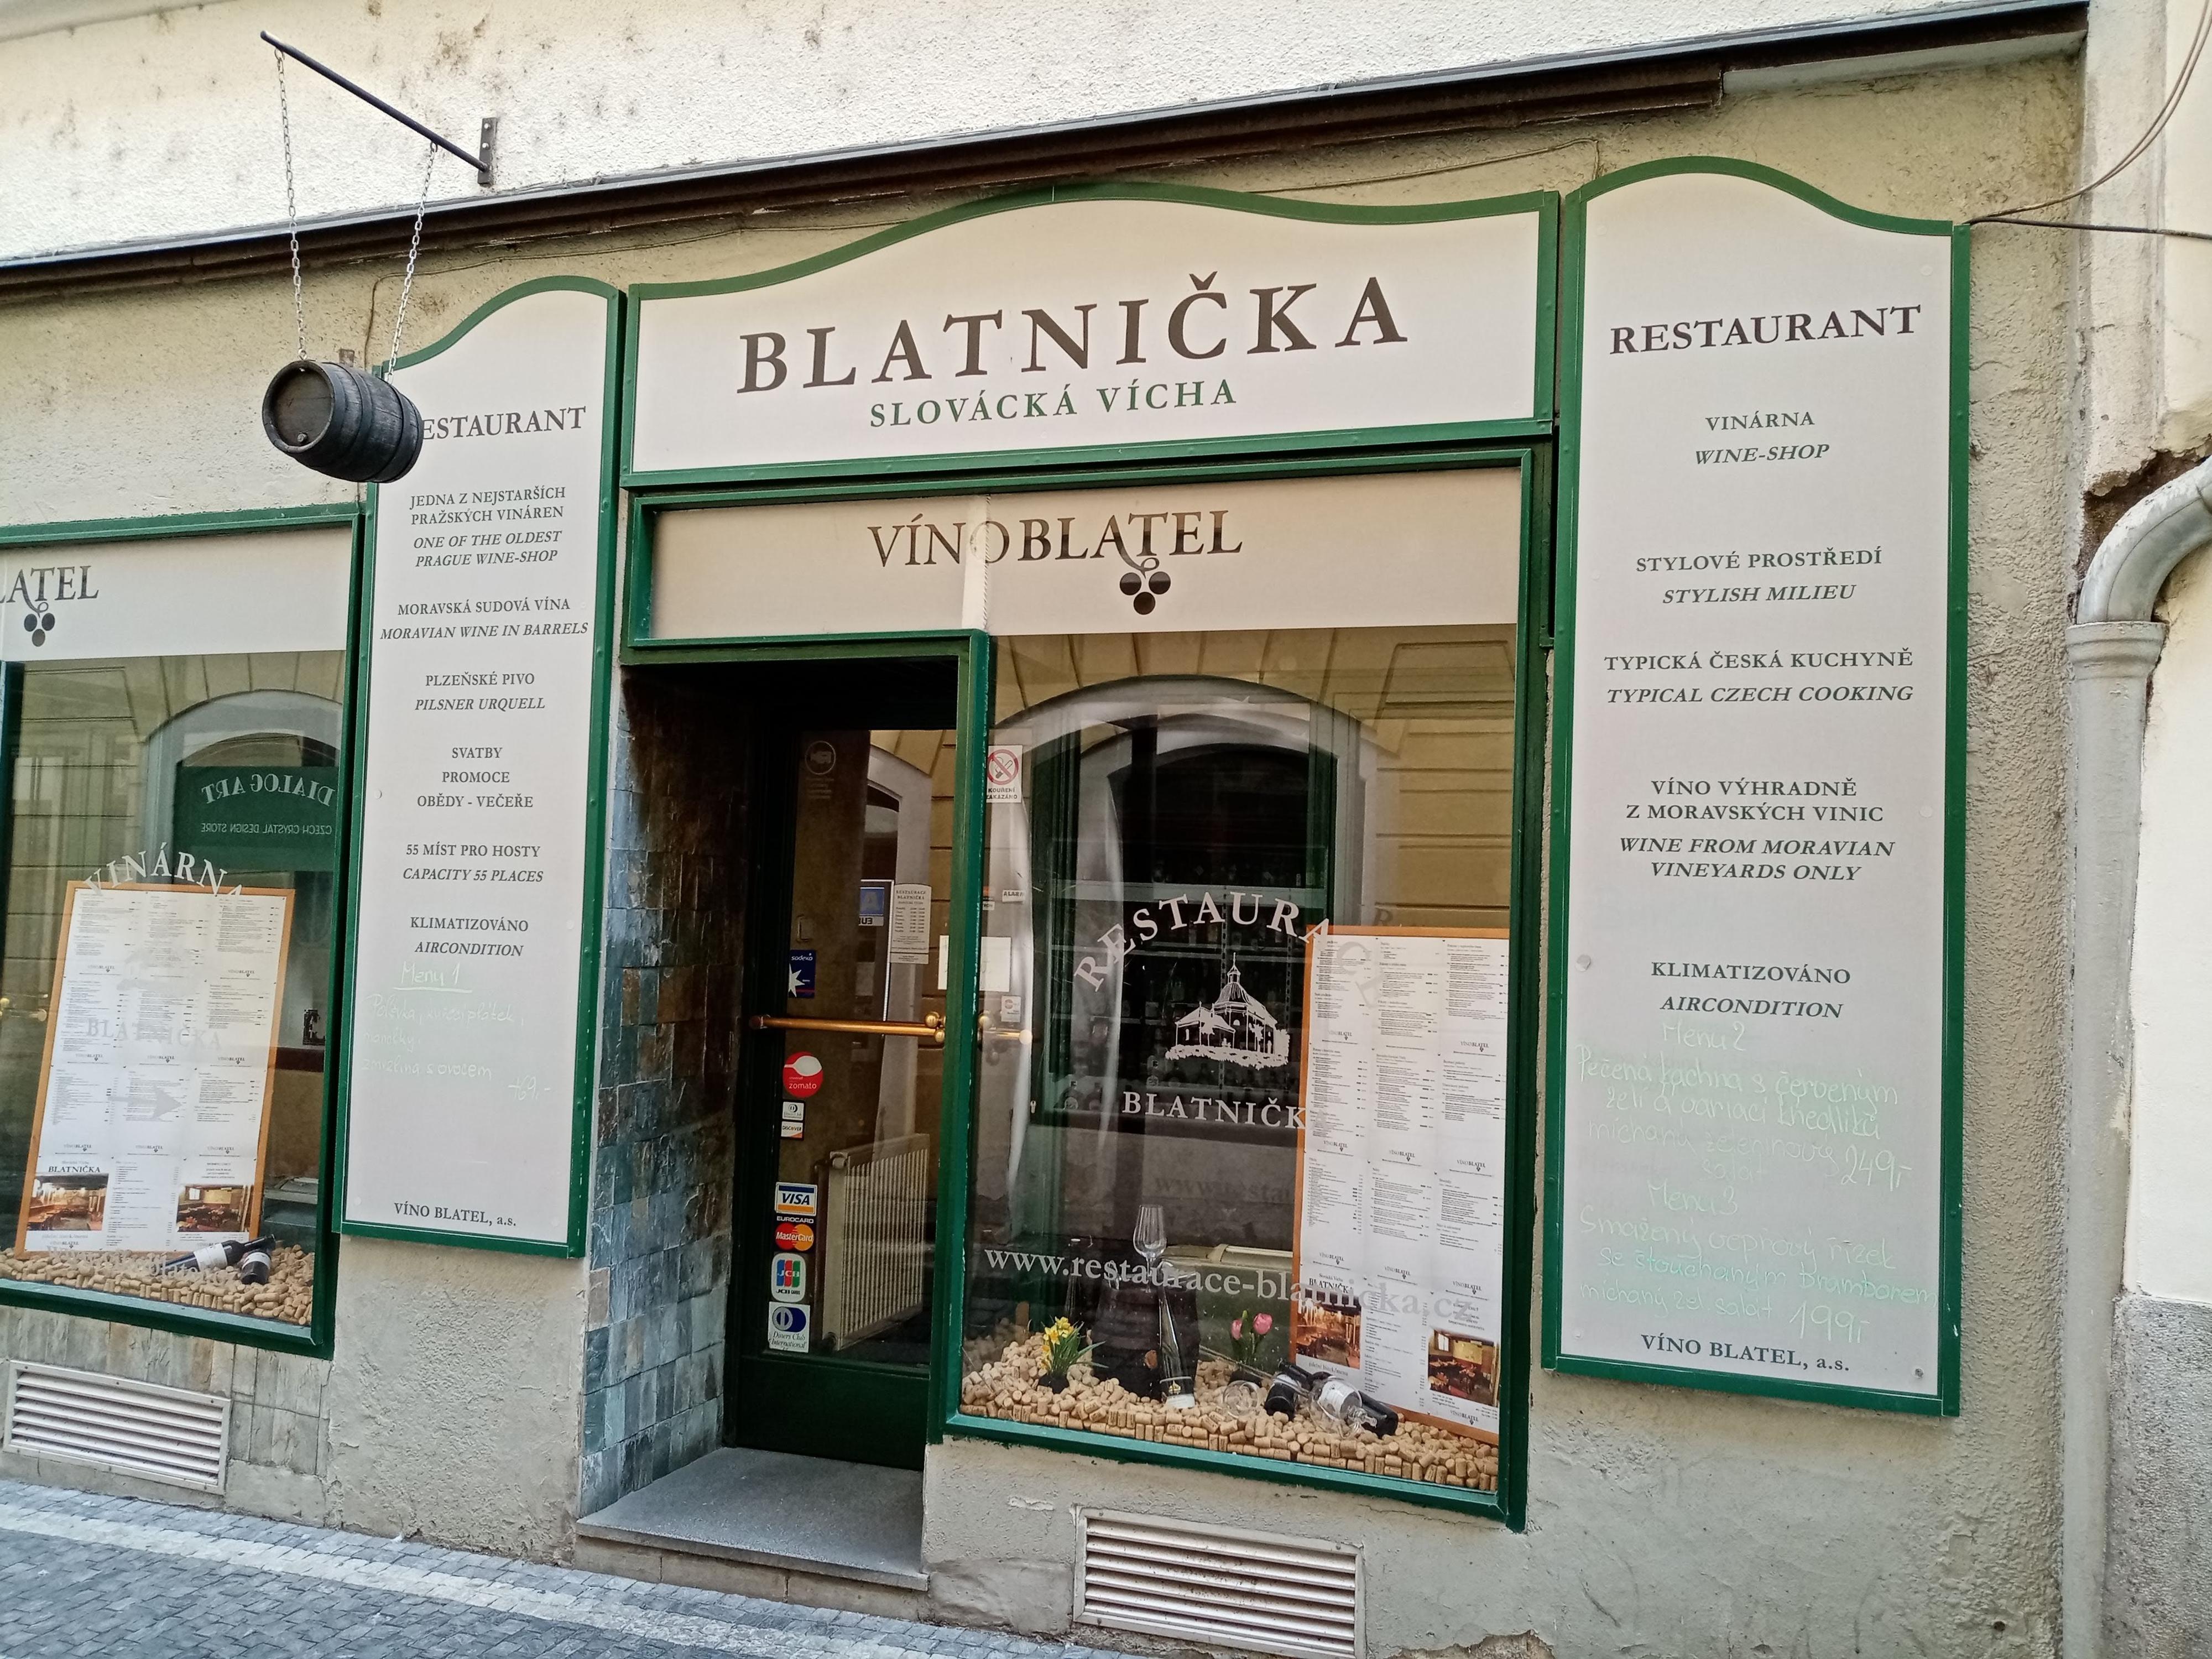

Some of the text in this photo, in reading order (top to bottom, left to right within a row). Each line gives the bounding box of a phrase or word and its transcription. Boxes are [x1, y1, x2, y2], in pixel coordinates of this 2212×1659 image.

[737, 272, 1408, 395] BLATNIČKA
[1609, 304, 1921, 355] RESTAURANT
[870, 378, 1237, 427] SLOVÁCKÁ VÍCHA
[420, 406, 587, 441] ESTAURANT
[1705, 410, 1815, 431] VINÁRNA
[1695, 444, 1830, 465] WINE-SHOP
[409, 485, 566, 510] JEDNA Z NEJSTARŠÍCH
[411, 504, 564, 525] PRAŽSKÝCH VINÁREN
[414, 530, 562, 549] ONE OF THE OLDEST
[415, 550, 558, 567] PRAGUE WINE-SHOP
[1636, 545, 1882, 572] STYLOVÉ PROSTŘEDÍ
[1662, 585, 1857, 604] STYLISH MILIEU
[398, 596, 571, 615] MORAVSKÁ SUDOVÁ VÍNA
[380, 622, 588, 639] MORAVIAN WINE IN BARRELS
[1604, 647, 1913, 670] TYPICKÁ ČESKÁ KUCHYNĚ
[425, 671, 535, 686] PLZEŇSKÉ PIVO
[1607, 686, 1913, 703] TYPICAL CZECH COOKING
[415, 697, 545, 712] PILSNER URQUELL
[452, 747, 503, 759] SVATBY
[442, 771, 510, 783] PROMOCE
[1651, 776, 1857, 796] VÍNO VÝHRADNĚ
[417, 792, 465, 807] OBĚDY
[476, 793, 533, 808] VEČEŘE
[1626, 802, 1883, 822] Z MORAVSKÝCH VINIC
[406, 841, 541, 857] 55 MÍST PRO HOSTY
[1620, 837, 1896, 857] WINE FROM MORAVIAN
[403, 868, 544, 882] CAPACITY 55 PLACES
[1651, 862, 1862, 880] VINEYARDS ONLY
[410, 916, 529, 932] KLIMATIZOVÁNO
[414, 941, 524, 957] AIRCONDITION
[791, 953, 813, 961] sodexo
[1651, 962, 1850, 984] KLIMATIZOVÁNO
[1659, 996, 1844, 1018] AIRCONDITION
[1733, 1022, 1747, 1051] 2
[782, 1193, 810, 1205] VISA
[394, 1201, 516, 1227] VÍNO BLATEL, a.s.
[776, 1232, 813, 1243] MasterCard
[771, 1339, 806, 1349] International
[1641, 1332, 1850, 1372] VÍNO BLATEL, a.s.
